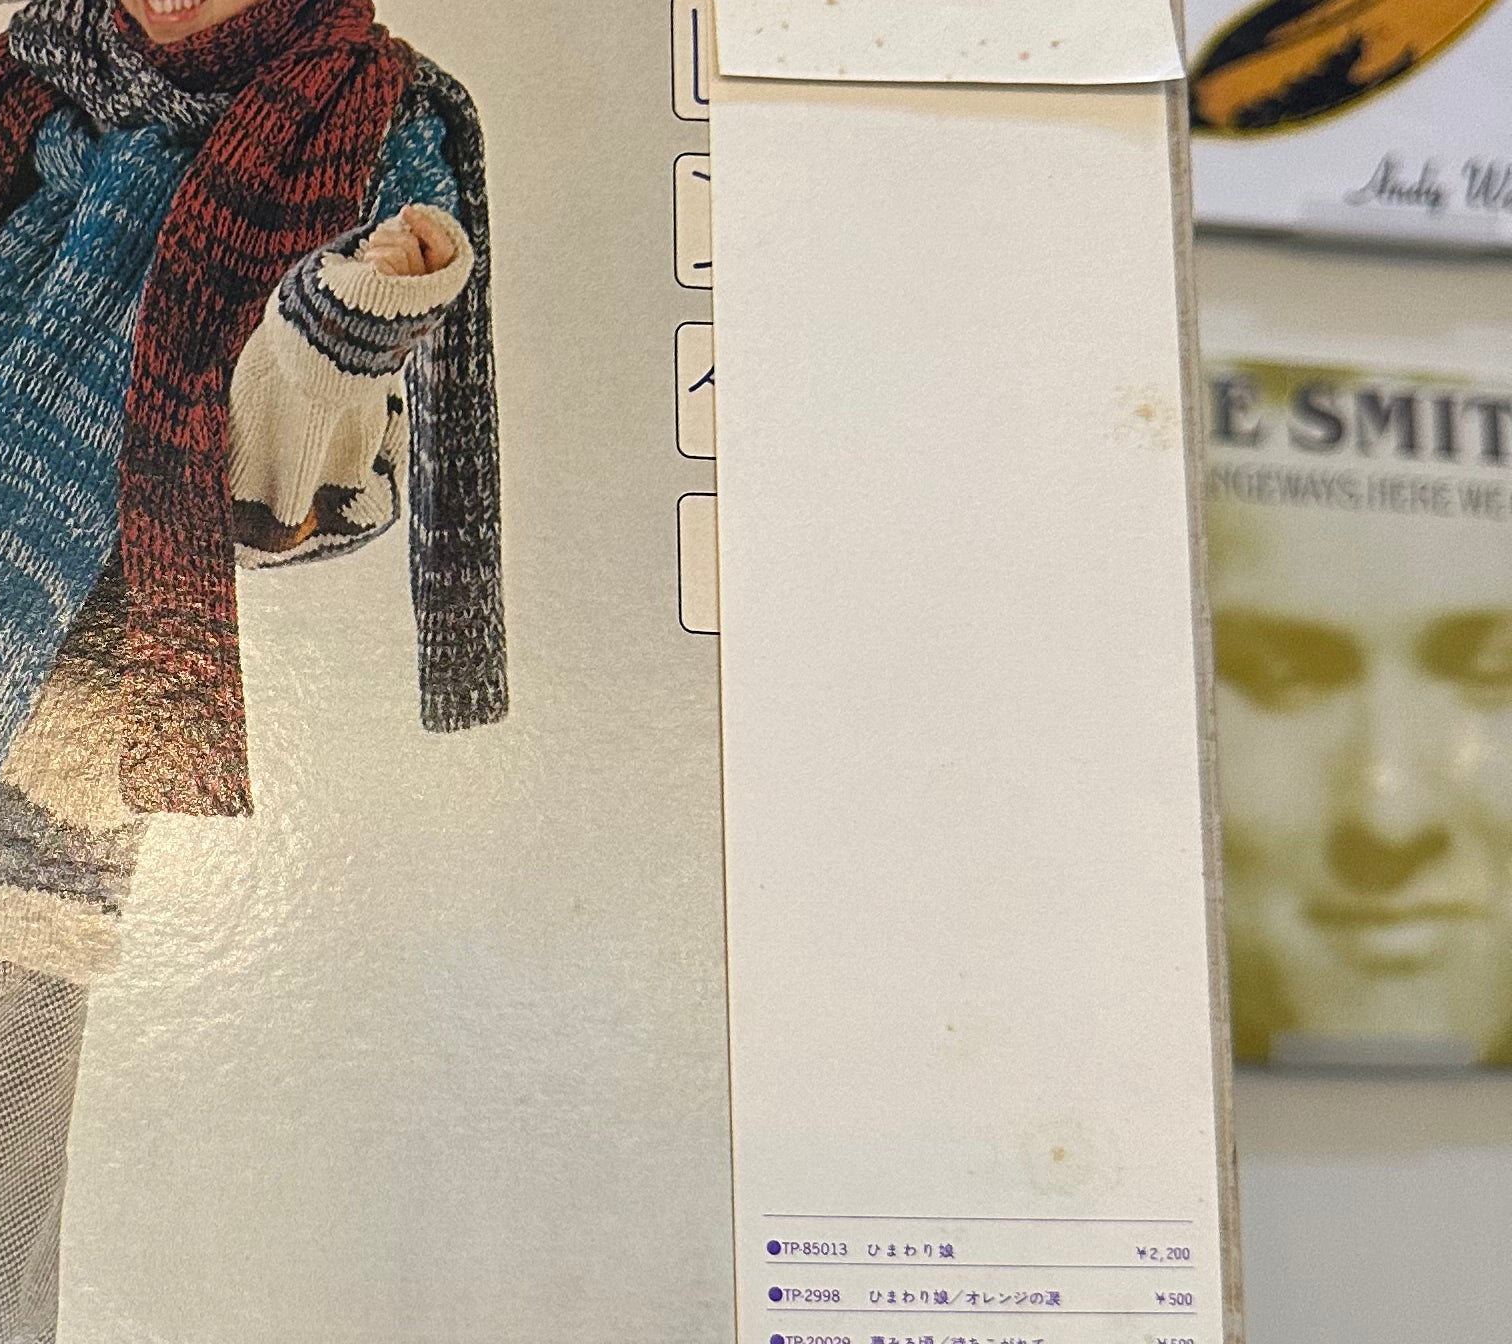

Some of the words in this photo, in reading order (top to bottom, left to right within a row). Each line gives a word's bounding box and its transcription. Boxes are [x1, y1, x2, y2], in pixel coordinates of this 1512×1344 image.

[782, 1241, 848, 1256] TP-85013
[867, 1243, 955, 1259] ひまわり娘
[1137, 1246, 1191, 1262] ¥2,200
[783, 1288, 841, 1303] TP-2998
[1156, 1292, 1193, 1306] ¥500
